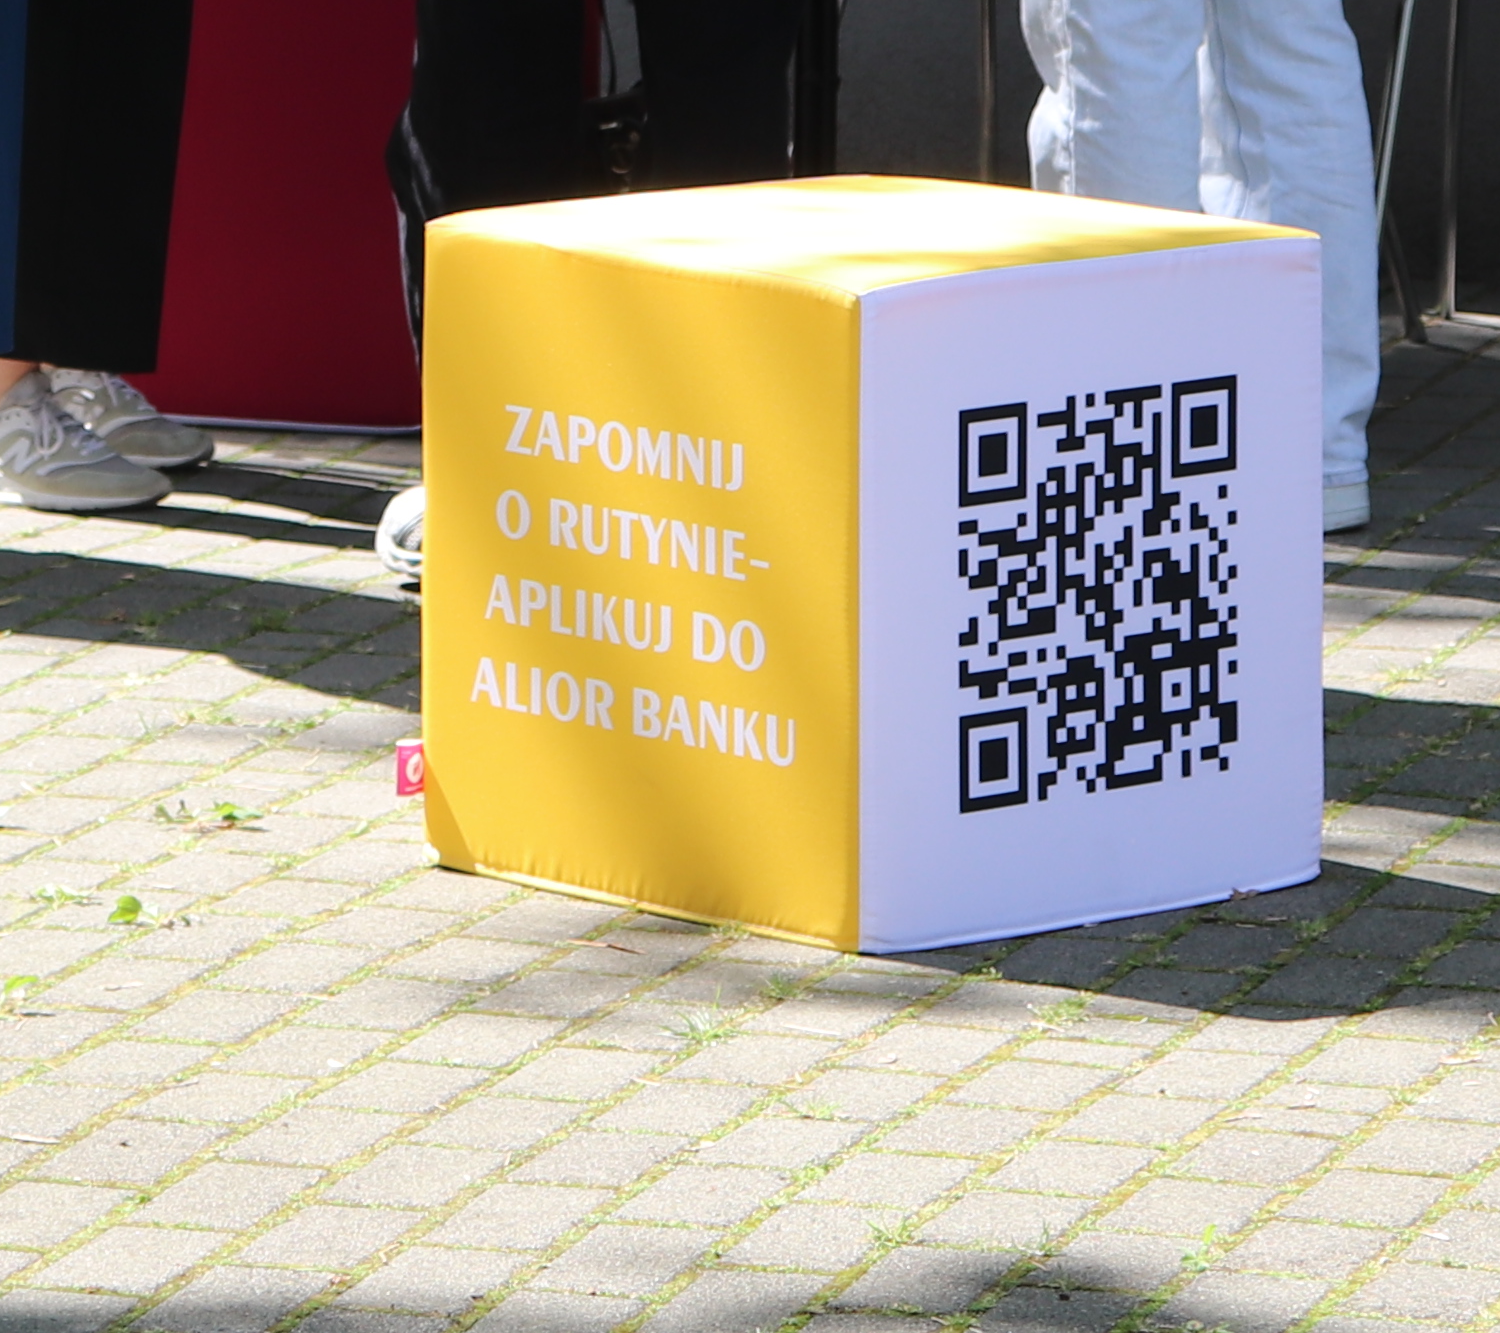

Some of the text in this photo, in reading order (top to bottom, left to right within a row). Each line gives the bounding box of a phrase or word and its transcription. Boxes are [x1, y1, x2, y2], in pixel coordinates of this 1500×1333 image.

[505, 404, 743, 491] ZAPOMNIJ
[496, 489, 530, 540] O
[484, 574, 766, 672] APLIKUJ DO
[471, 657, 796, 767] ALIOR BANKU
